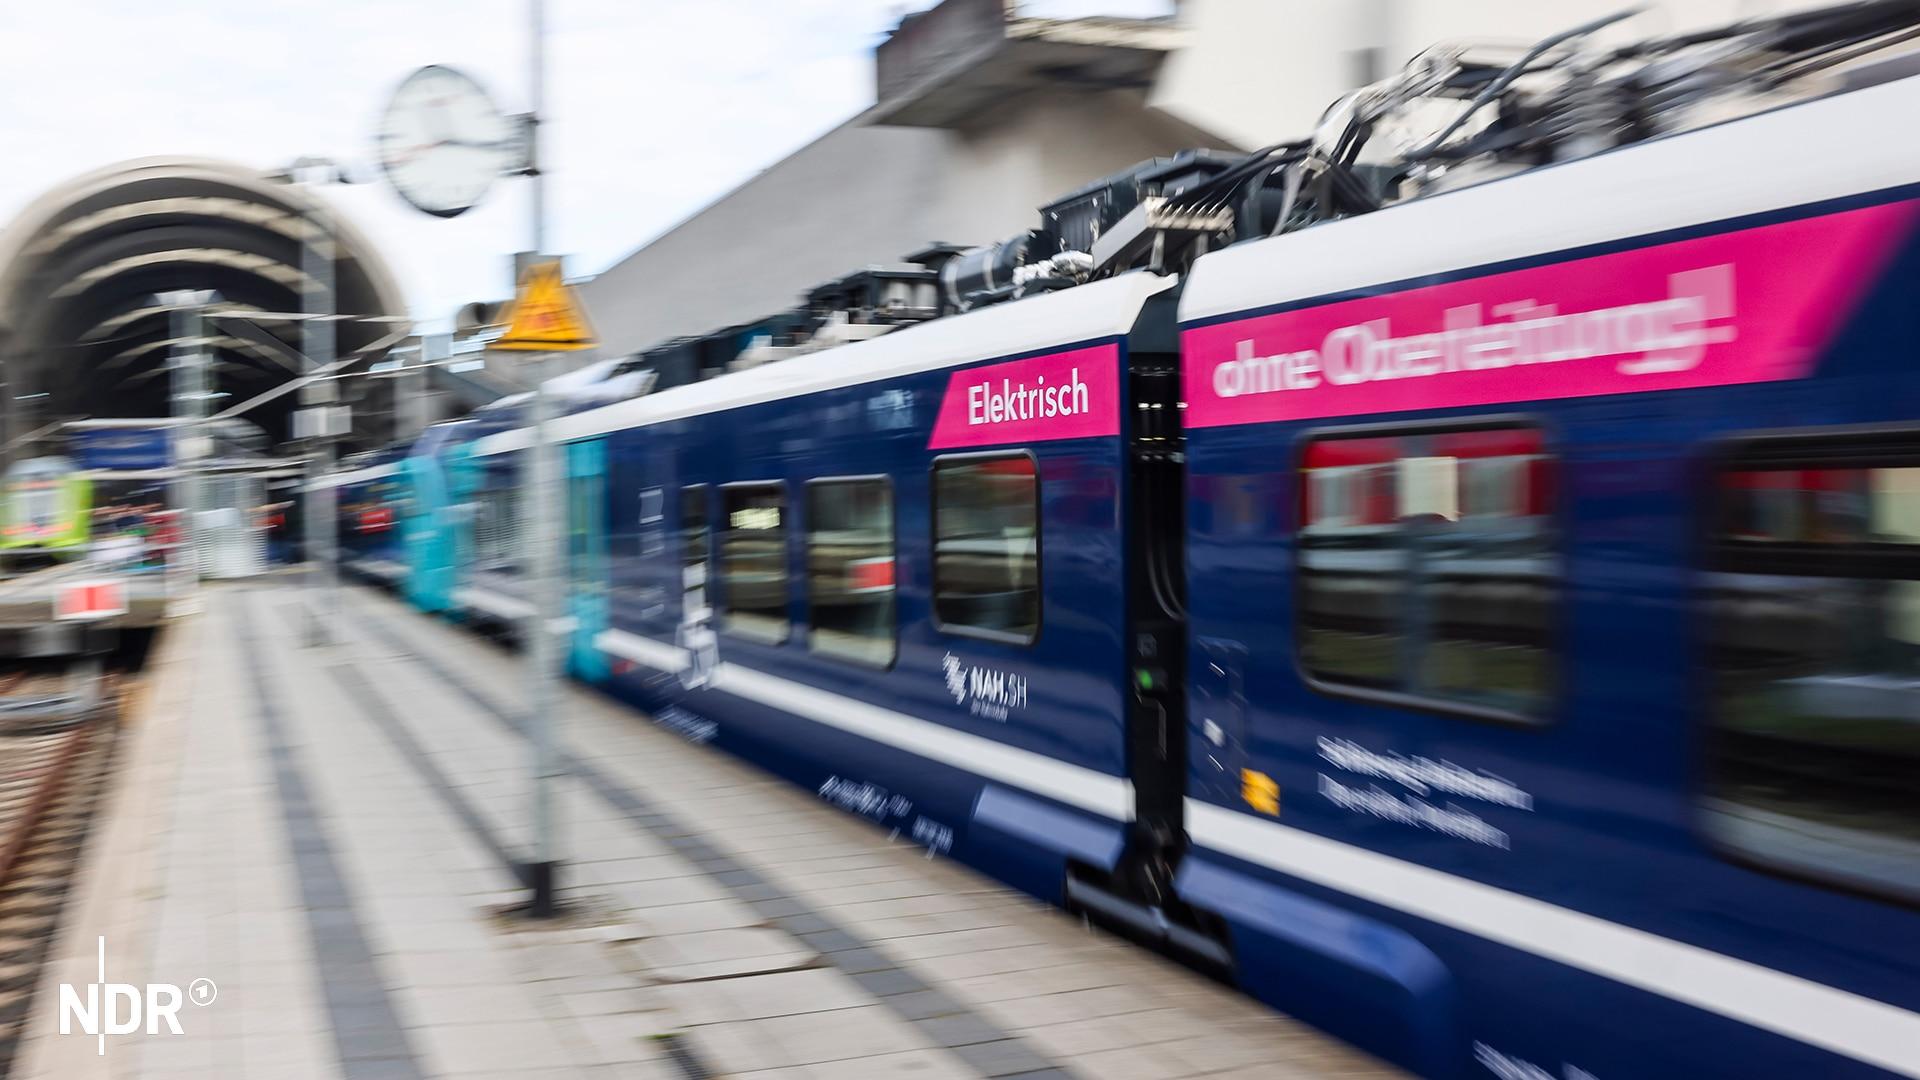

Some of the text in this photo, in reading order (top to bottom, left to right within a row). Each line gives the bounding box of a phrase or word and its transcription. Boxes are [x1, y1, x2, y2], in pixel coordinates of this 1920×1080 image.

[968, 367, 1089, 426] Elektrisch
[1213, 339, 1321, 397] ohne
[970, 666, 1027, 710] NAH.SH
